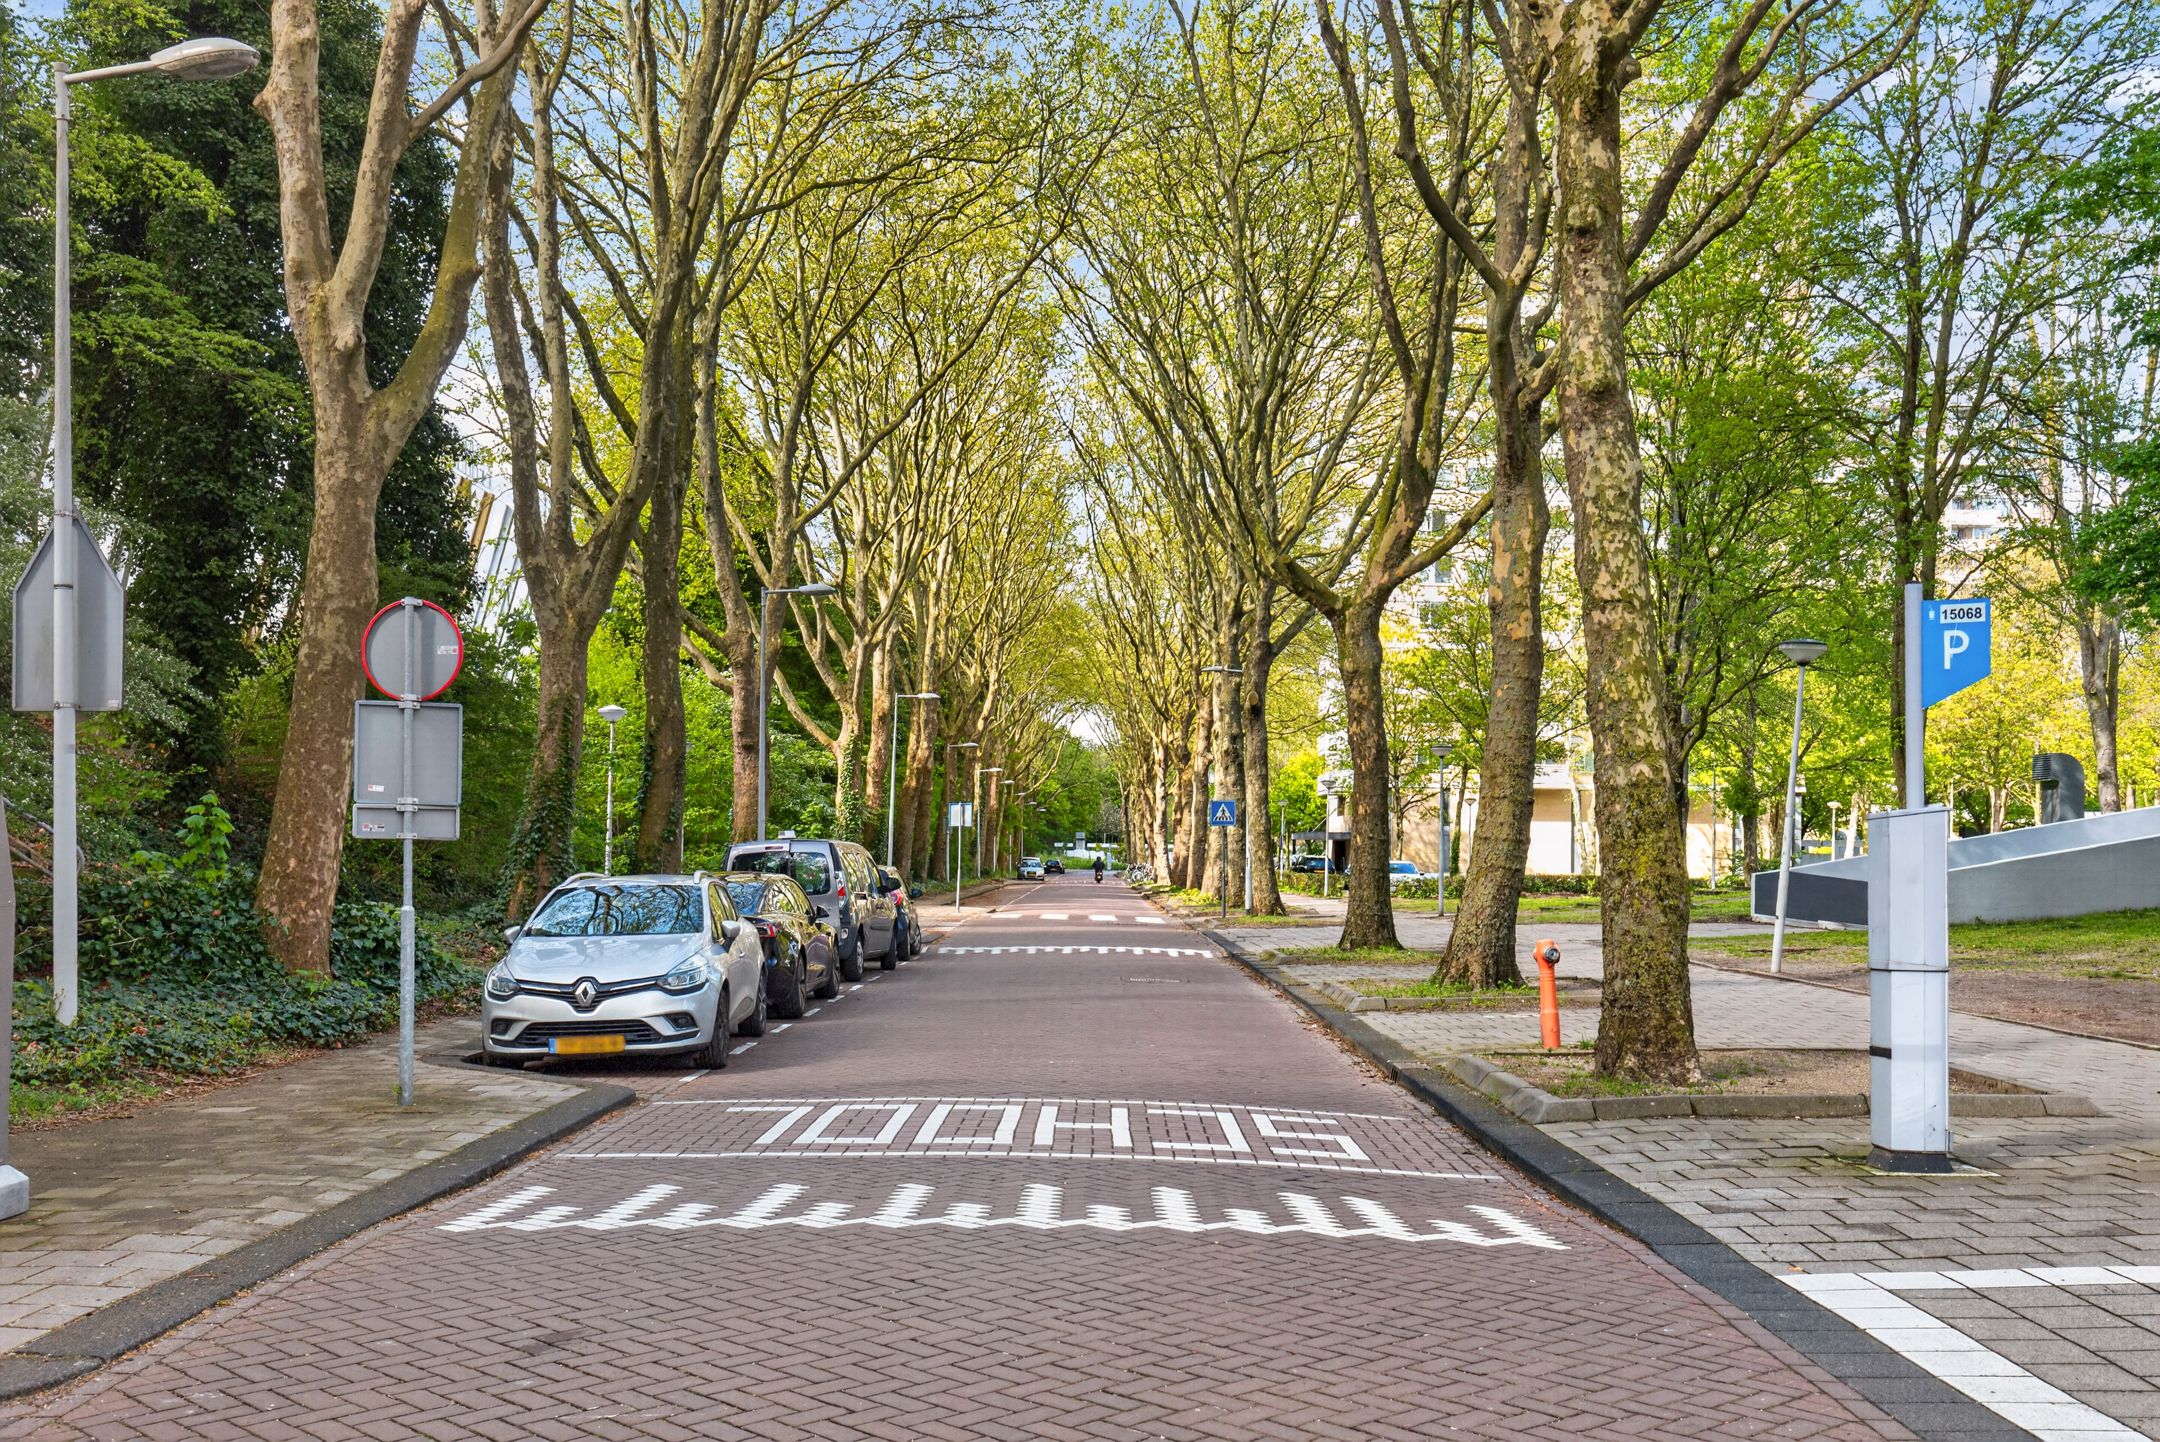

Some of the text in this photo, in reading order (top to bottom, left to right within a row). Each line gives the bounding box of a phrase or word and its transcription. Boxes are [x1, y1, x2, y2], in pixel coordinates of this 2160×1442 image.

[1942, 607, 1982, 620] 15068
[1944, 630, 1969, 669] P
[725, 1103, 1371, 1161] SCHOOL
